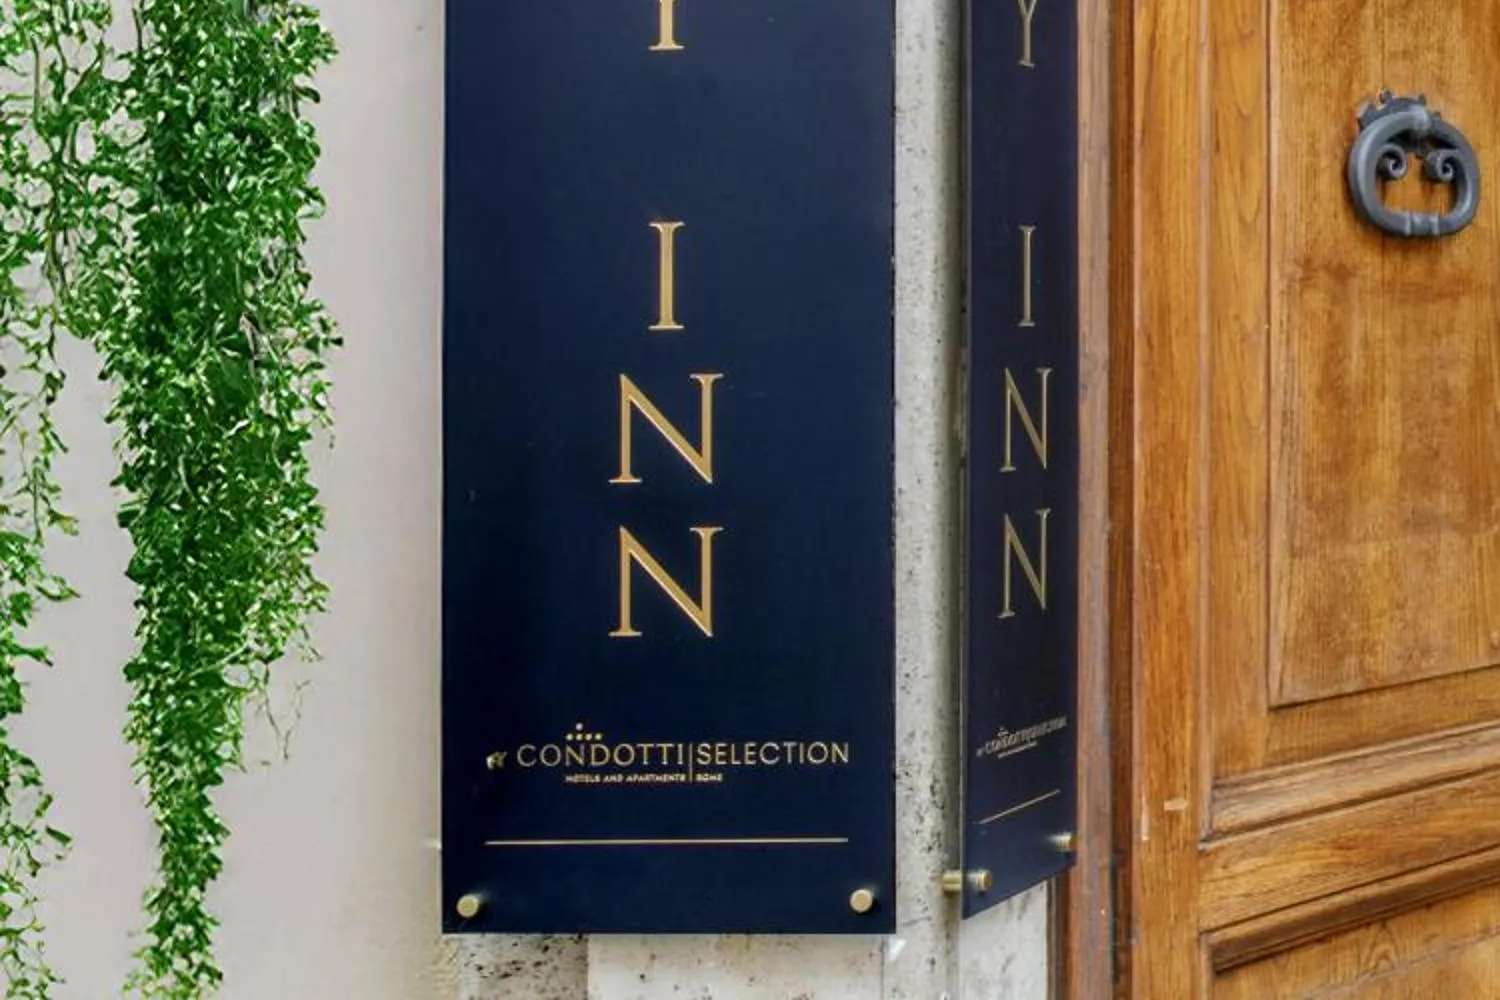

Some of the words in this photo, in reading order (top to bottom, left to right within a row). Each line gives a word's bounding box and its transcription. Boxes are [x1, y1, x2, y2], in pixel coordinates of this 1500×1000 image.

[608, 220, 724, 638] INN
[998, 224, 1053, 619] INN
[516, 743, 684, 767] CONDOTTI
[696, 741, 849, 766] SELECTION
